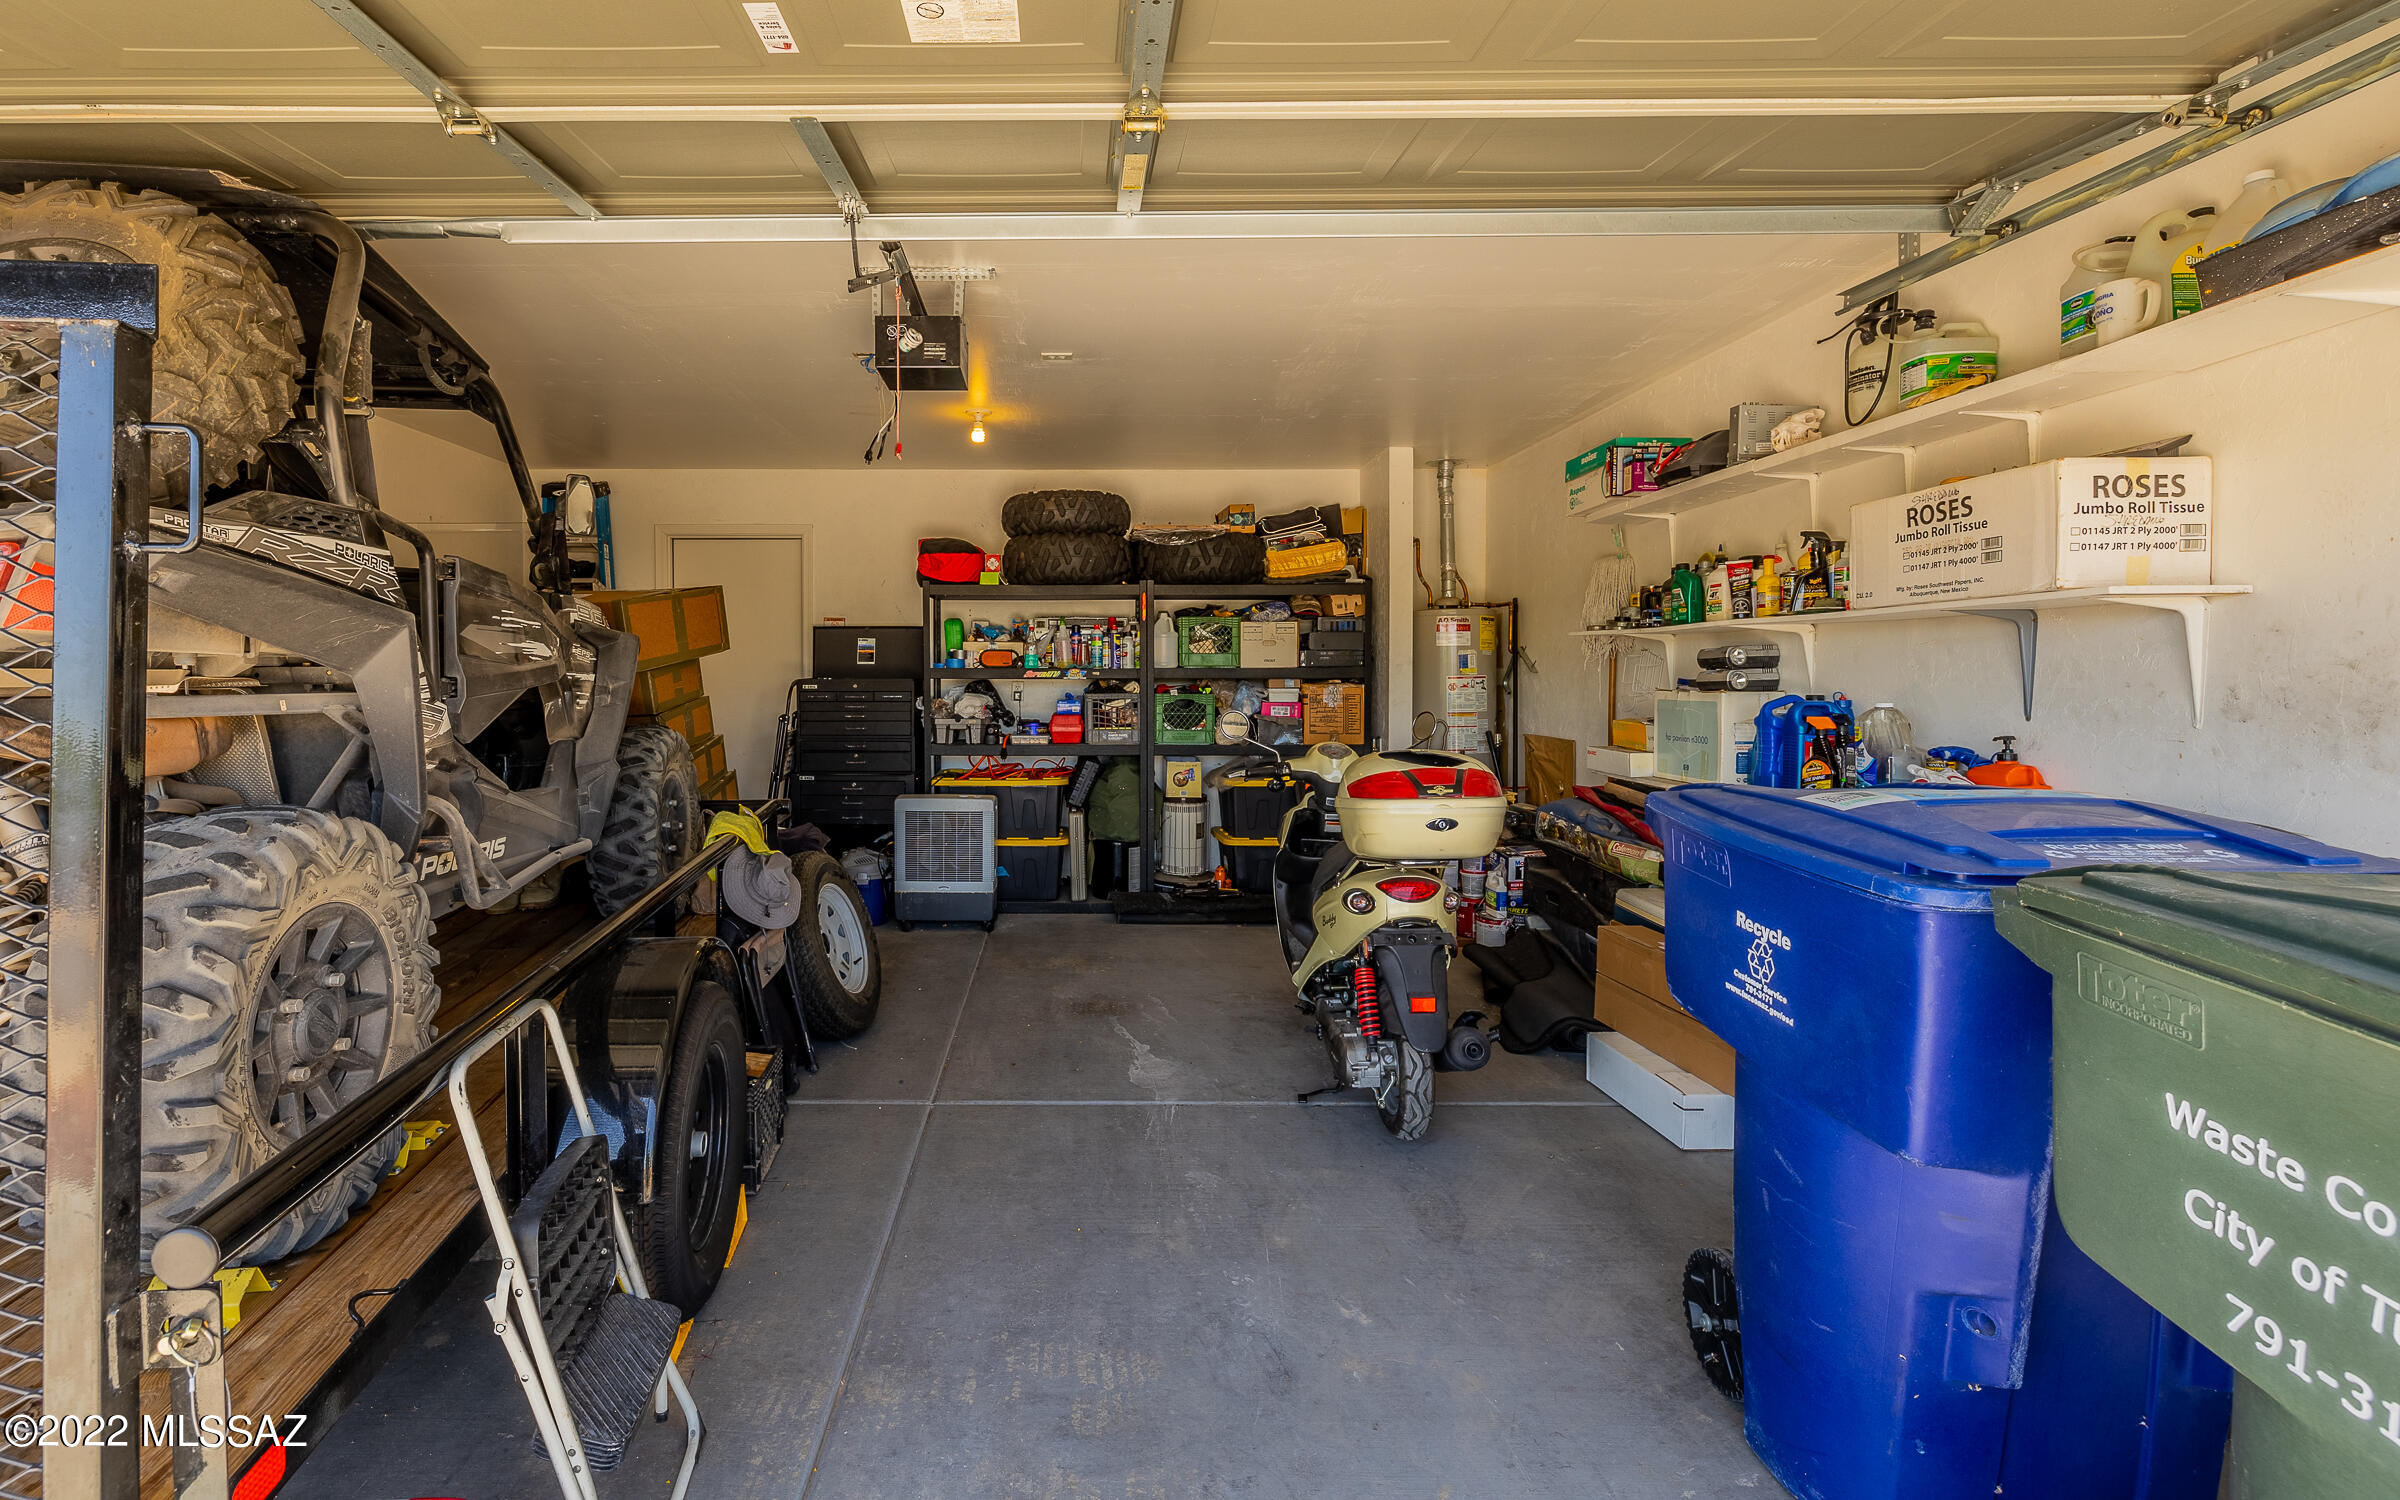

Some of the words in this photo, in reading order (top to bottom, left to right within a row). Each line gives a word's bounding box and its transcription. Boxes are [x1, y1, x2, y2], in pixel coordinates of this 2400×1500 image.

[2092, 474, 2186, 498] ROSES
[1906, 496, 1973, 528] ROSES
[2074, 502, 2124, 514] Jumbo
[2128, 501, 2156, 514] Roll
[2159, 501, 2205, 513] Tissue
[164, 514, 229, 539] PROTAR
[1894, 530, 1928, 544] Jumbo
[1931, 524, 1950, 538] Roll
[1953, 520, 1988, 535] Tissue
[2082, 527, 2110, 535] 01145
[2112, 526, 2128, 534] JRT
[2138, 526, 2152, 536] Ply
[2154, 526, 2178, 534] 2000'
[334, 542, 390, 574] POLARIS
[1910, 550, 1930, 558] 01145
[1930, 548, 1942, 556] JRT
[1948, 544, 1958, 554] Ply
[2081, 543, 2109, 551] 01147
[2112, 542, 2128, 550] JRT
[2130, 542, 2134, 550] 1
[2138, 542, 2150, 552] Ply
[2152, 542, 2178, 550] 4000'
[235, 526, 401, 603] RZR
[1910, 562, 1930, 572] 01147
[1930, 560, 1942, 569] JRT
[1948, 558, 1958, 567] Ply
[1910, 589, 1939, 598] Albuquerque,
[1929, 580, 1954, 589] Southwest
[1672, 734, 1690, 744] pavilion
[1692, 736, 1708, 744] n3000
[420, 836, 507, 880] POLRIS
[1612, 842, 1640, 856] Coleman
[1736, 910, 1792, 951] Recycle
[382, 906, 416, 1015] BIGHORN
[1733, 968, 1763, 990] Customer
[1762, 984, 1788, 1005] Service
[1745, 982, 1774, 1005] 791-3171
[2102, 995, 2193, 1042] INCORPORATED
[2165, 1092, 2306, 1194] Waste
[2184, 1189, 2276, 1269] City
[2290, 1254, 2348, 1306] of
